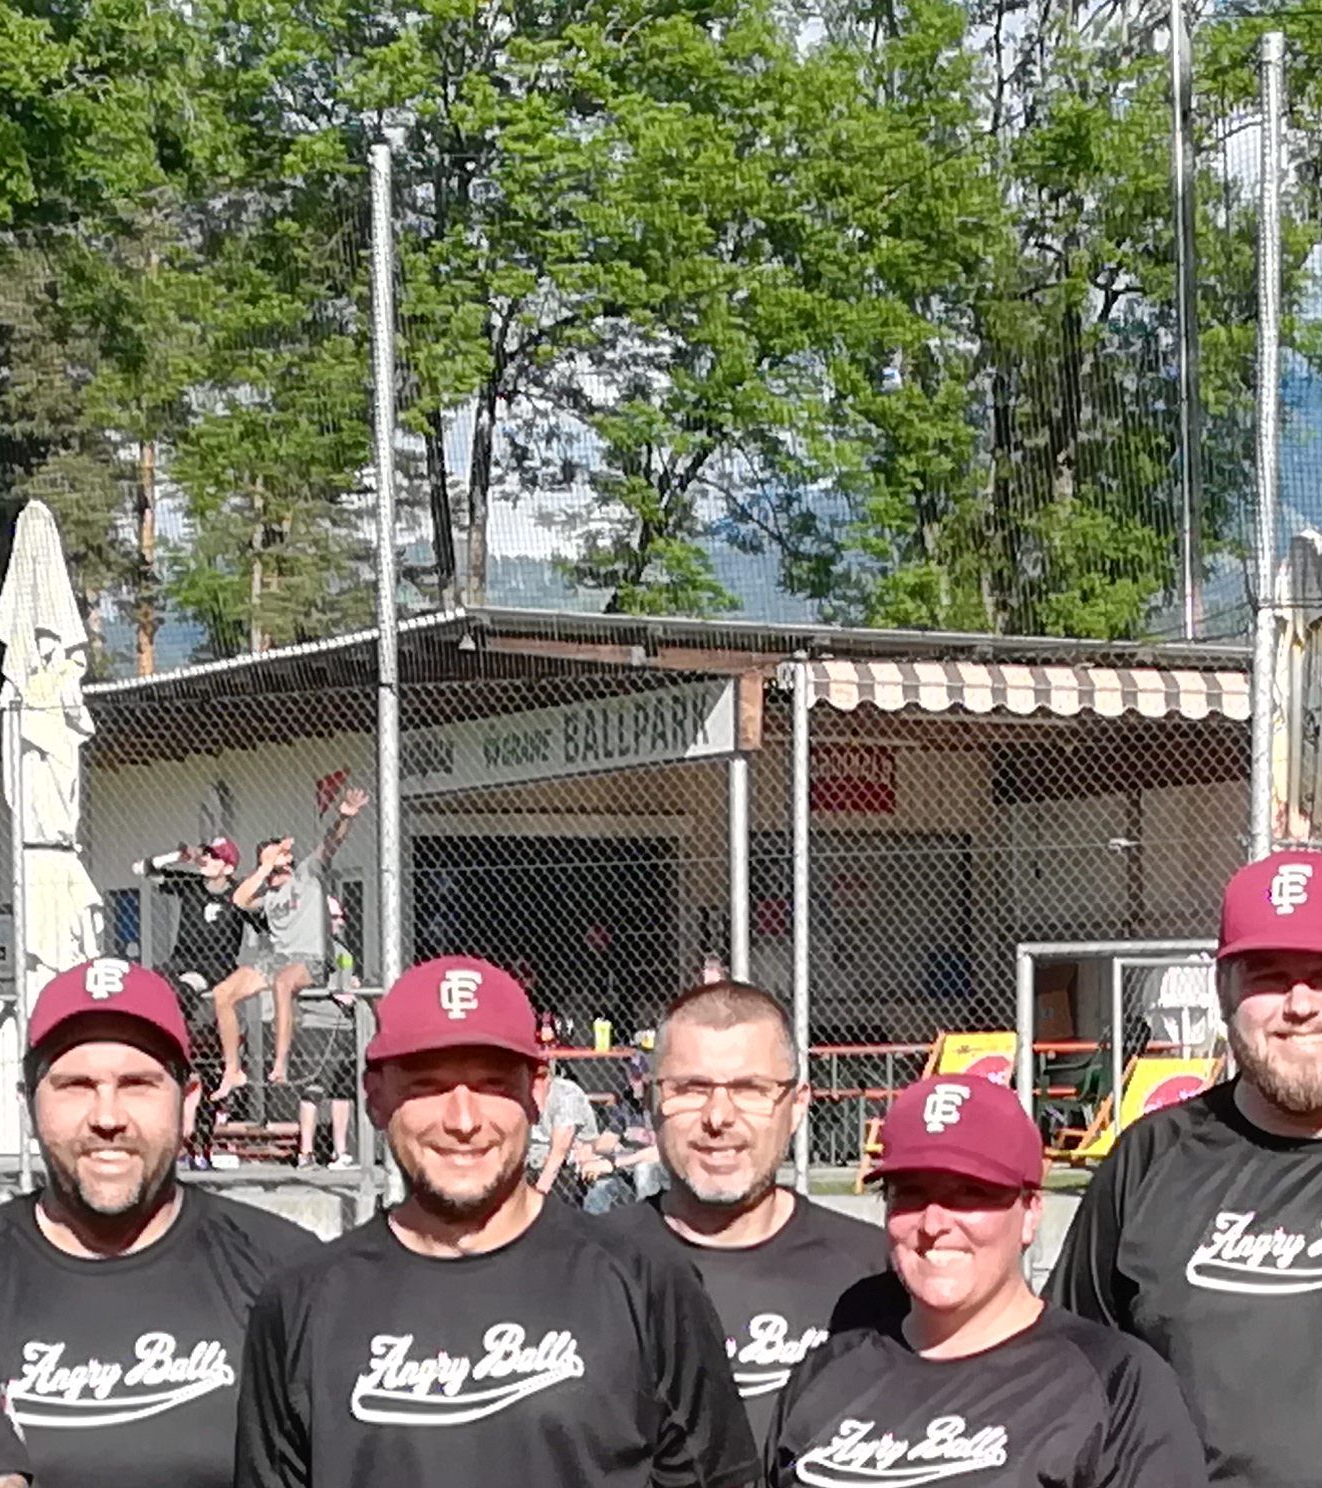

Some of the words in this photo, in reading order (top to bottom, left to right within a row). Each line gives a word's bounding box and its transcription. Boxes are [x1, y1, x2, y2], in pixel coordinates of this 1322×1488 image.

[1203, 1211, 1305, 1269] Angry
[18, 1342, 122, 1399] Angry
[124, 1332, 234, 1384] Balls
[362, 1334, 470, 1396] Angry
[472, 1322, 584, 1379] Balls
[908, 1415, 1008, 1463] Balls
